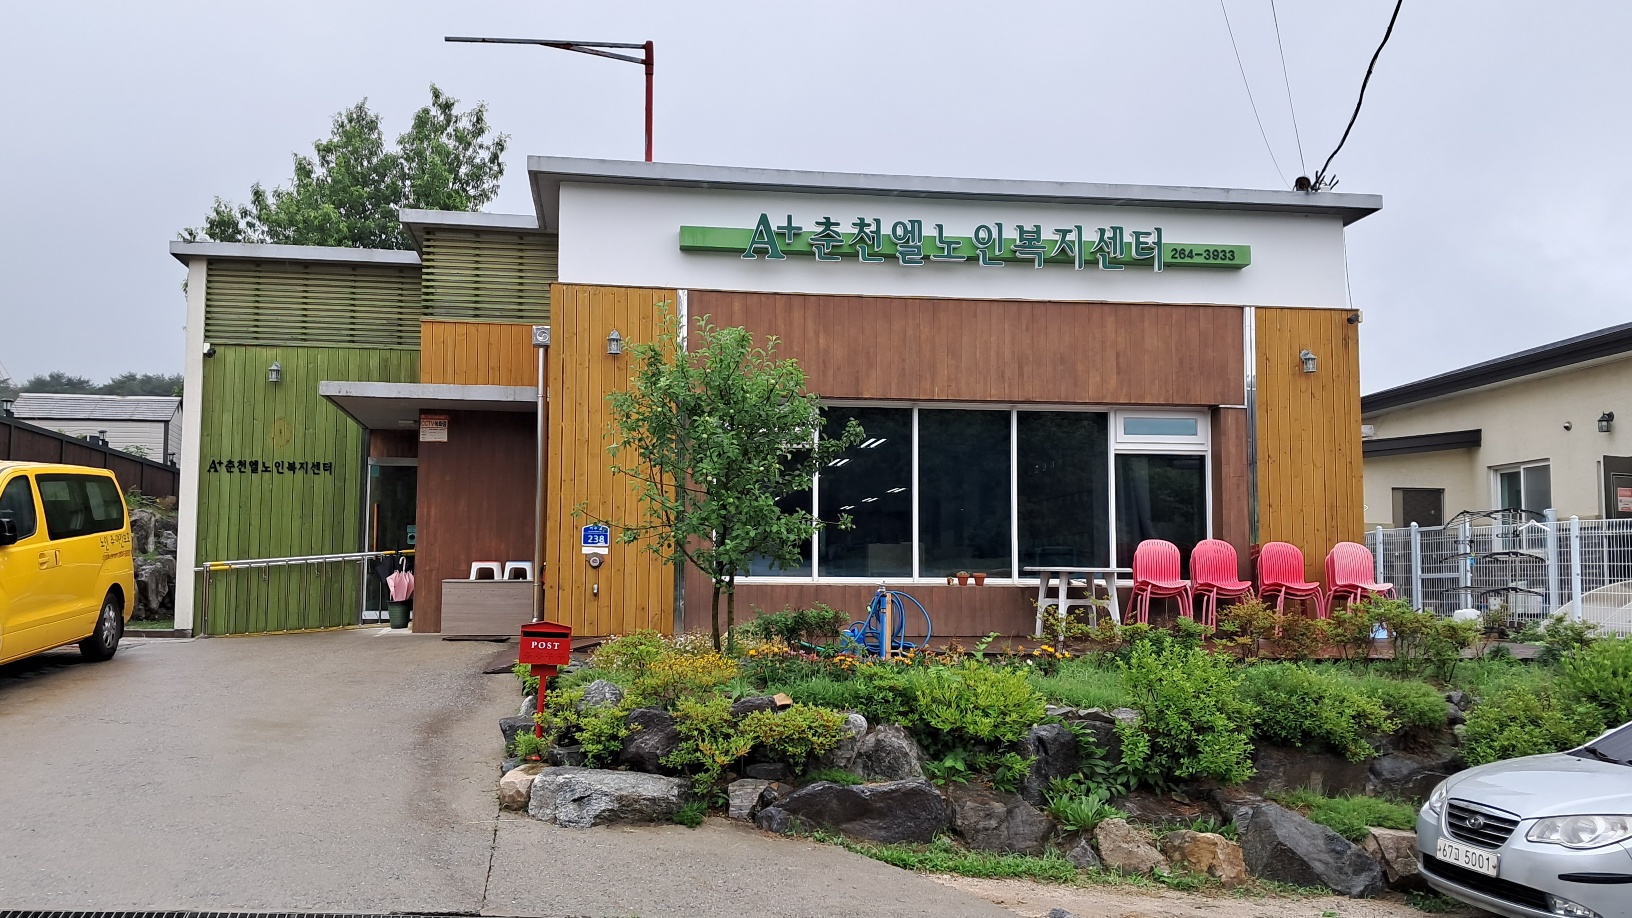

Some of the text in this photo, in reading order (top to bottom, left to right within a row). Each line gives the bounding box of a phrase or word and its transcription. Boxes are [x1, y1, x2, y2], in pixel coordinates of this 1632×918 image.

[1170, 247, 1237, 262] 264-3933
[587, 534, 605, 544] 238
[530, 640, 561, 651] POST
[1464, 849, 1490, 872] 5001
